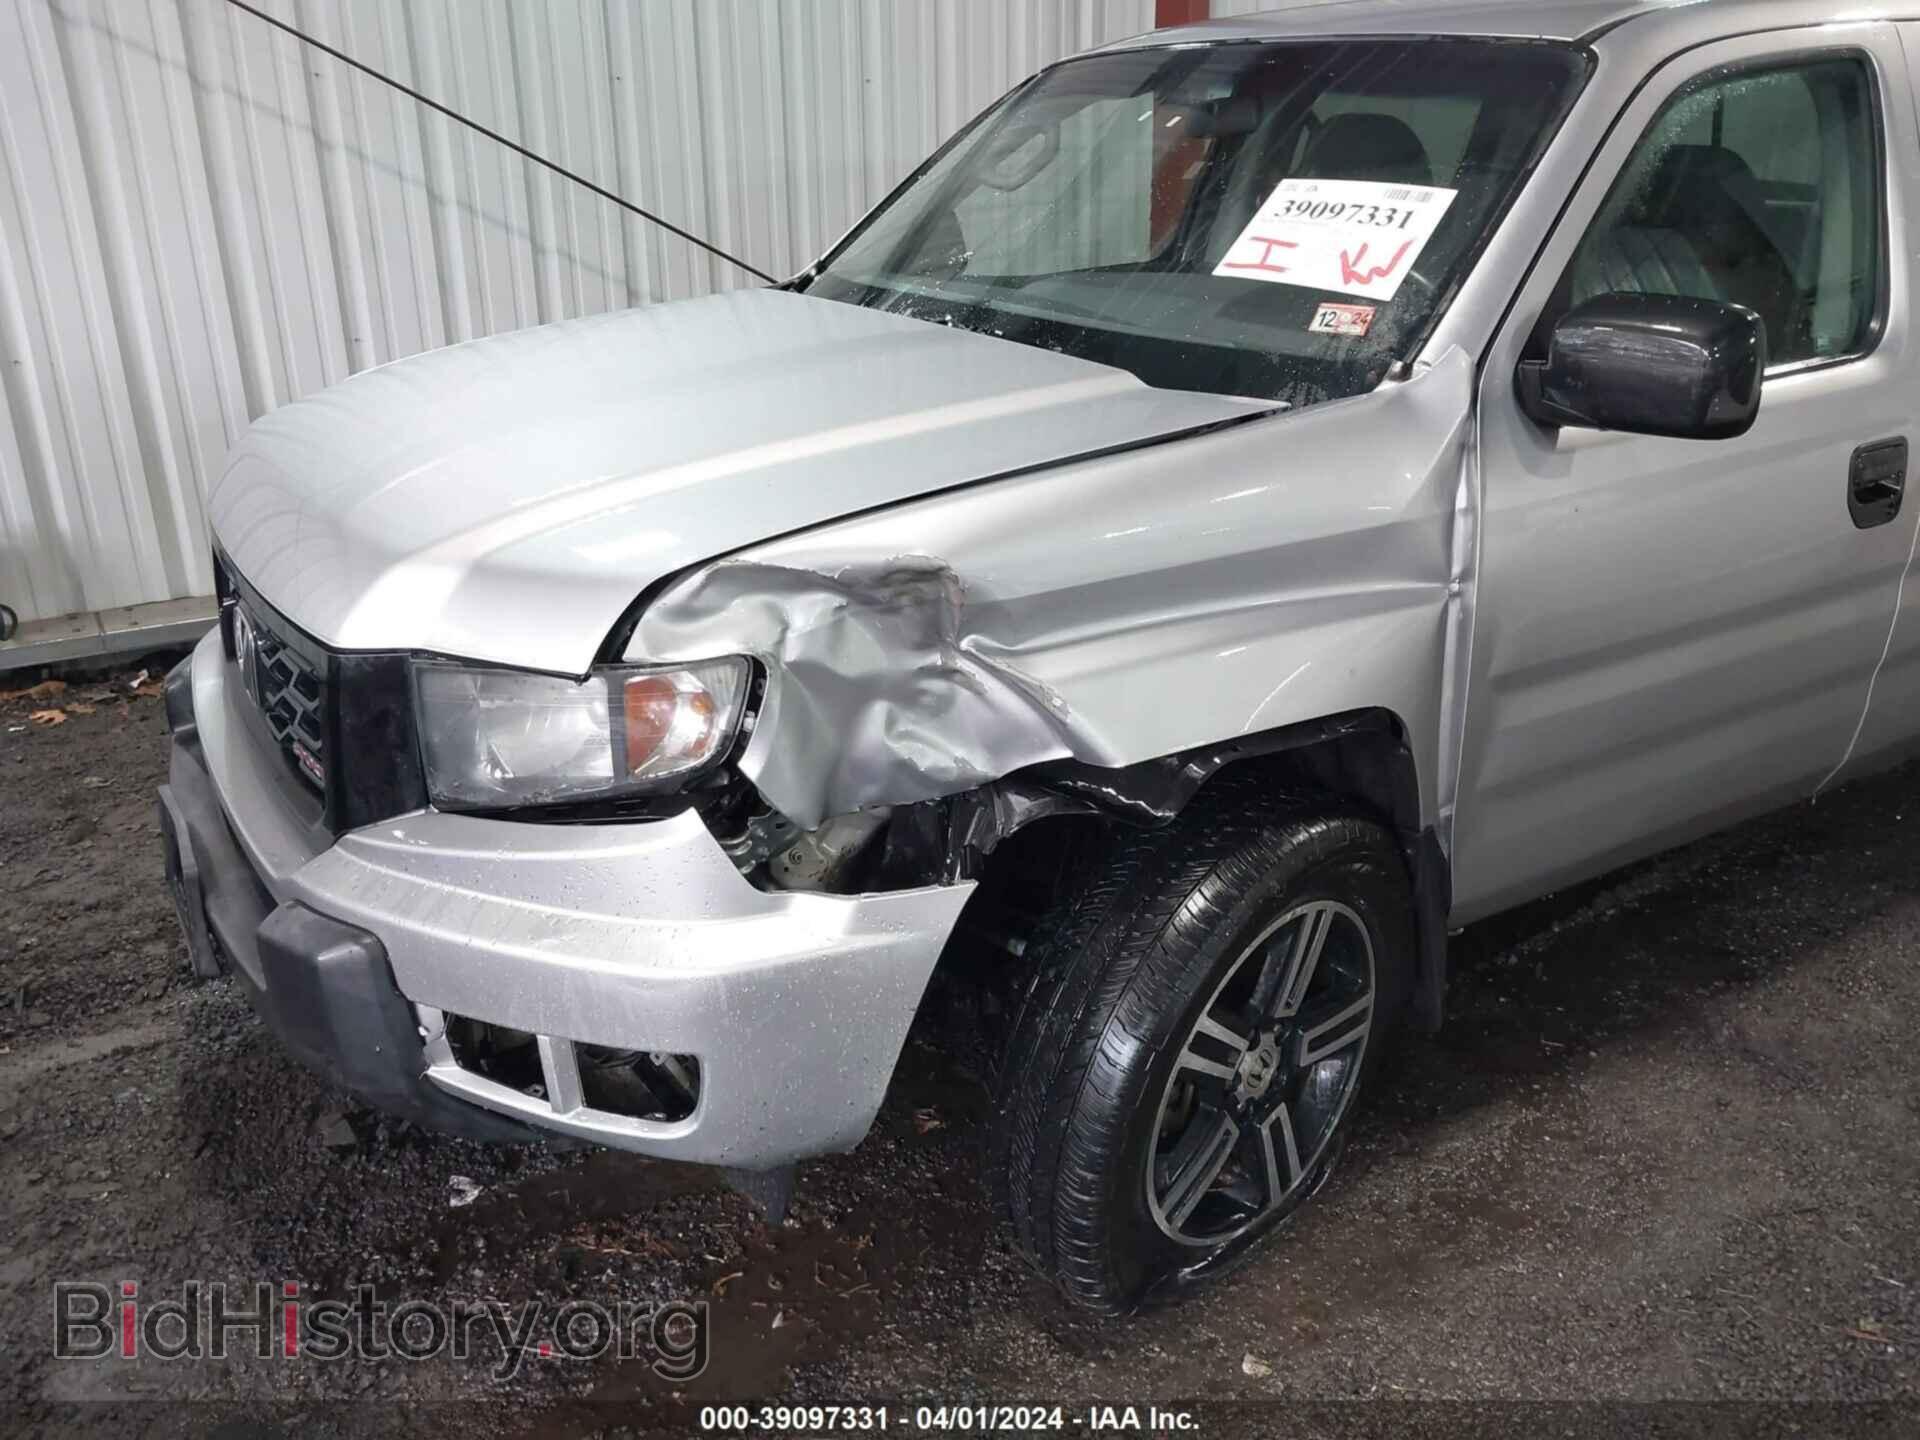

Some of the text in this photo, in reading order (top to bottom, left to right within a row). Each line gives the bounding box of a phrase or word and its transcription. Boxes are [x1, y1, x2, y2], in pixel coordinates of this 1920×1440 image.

[1274, 199, 1415, 229] 39097331
[1318, 311, 1370, 328] 12 24
